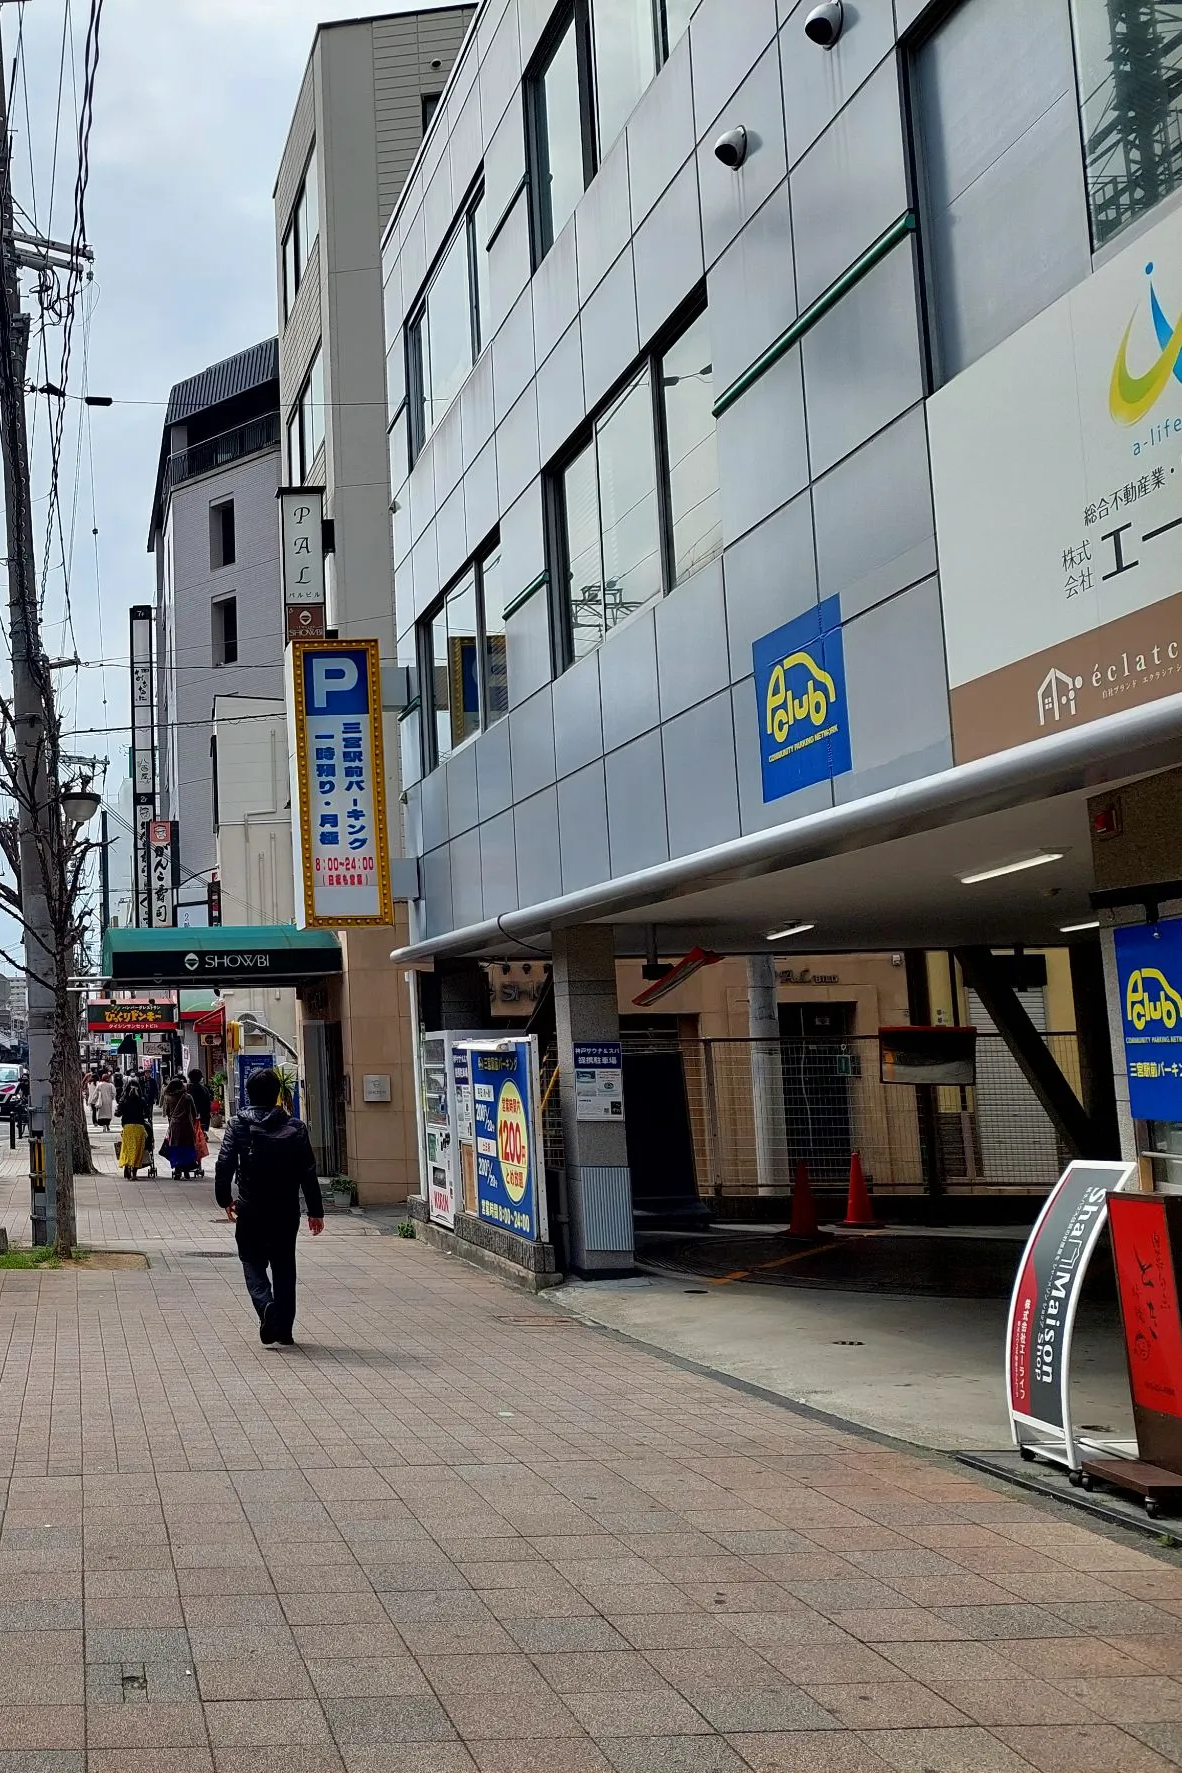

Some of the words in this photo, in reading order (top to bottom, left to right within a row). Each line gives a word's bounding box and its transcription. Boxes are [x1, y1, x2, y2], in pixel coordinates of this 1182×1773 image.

[293, 506, 312, 584] PAL
[312, 657, 359, 708] P
[315, 733, 339, 846] 一時預り・月極
[342, 721, 368, 851] 三宮駅前パーキング
[153, 842, 171, 923] がんこ寿司
[205, 954, 269, 968] SHOWBI
[104, 1010, 162, 1022] びっくりドンキー
[1035, 1331, 1044, 1381] Shop
[1041, 1270, 1071, 1384] Maison
